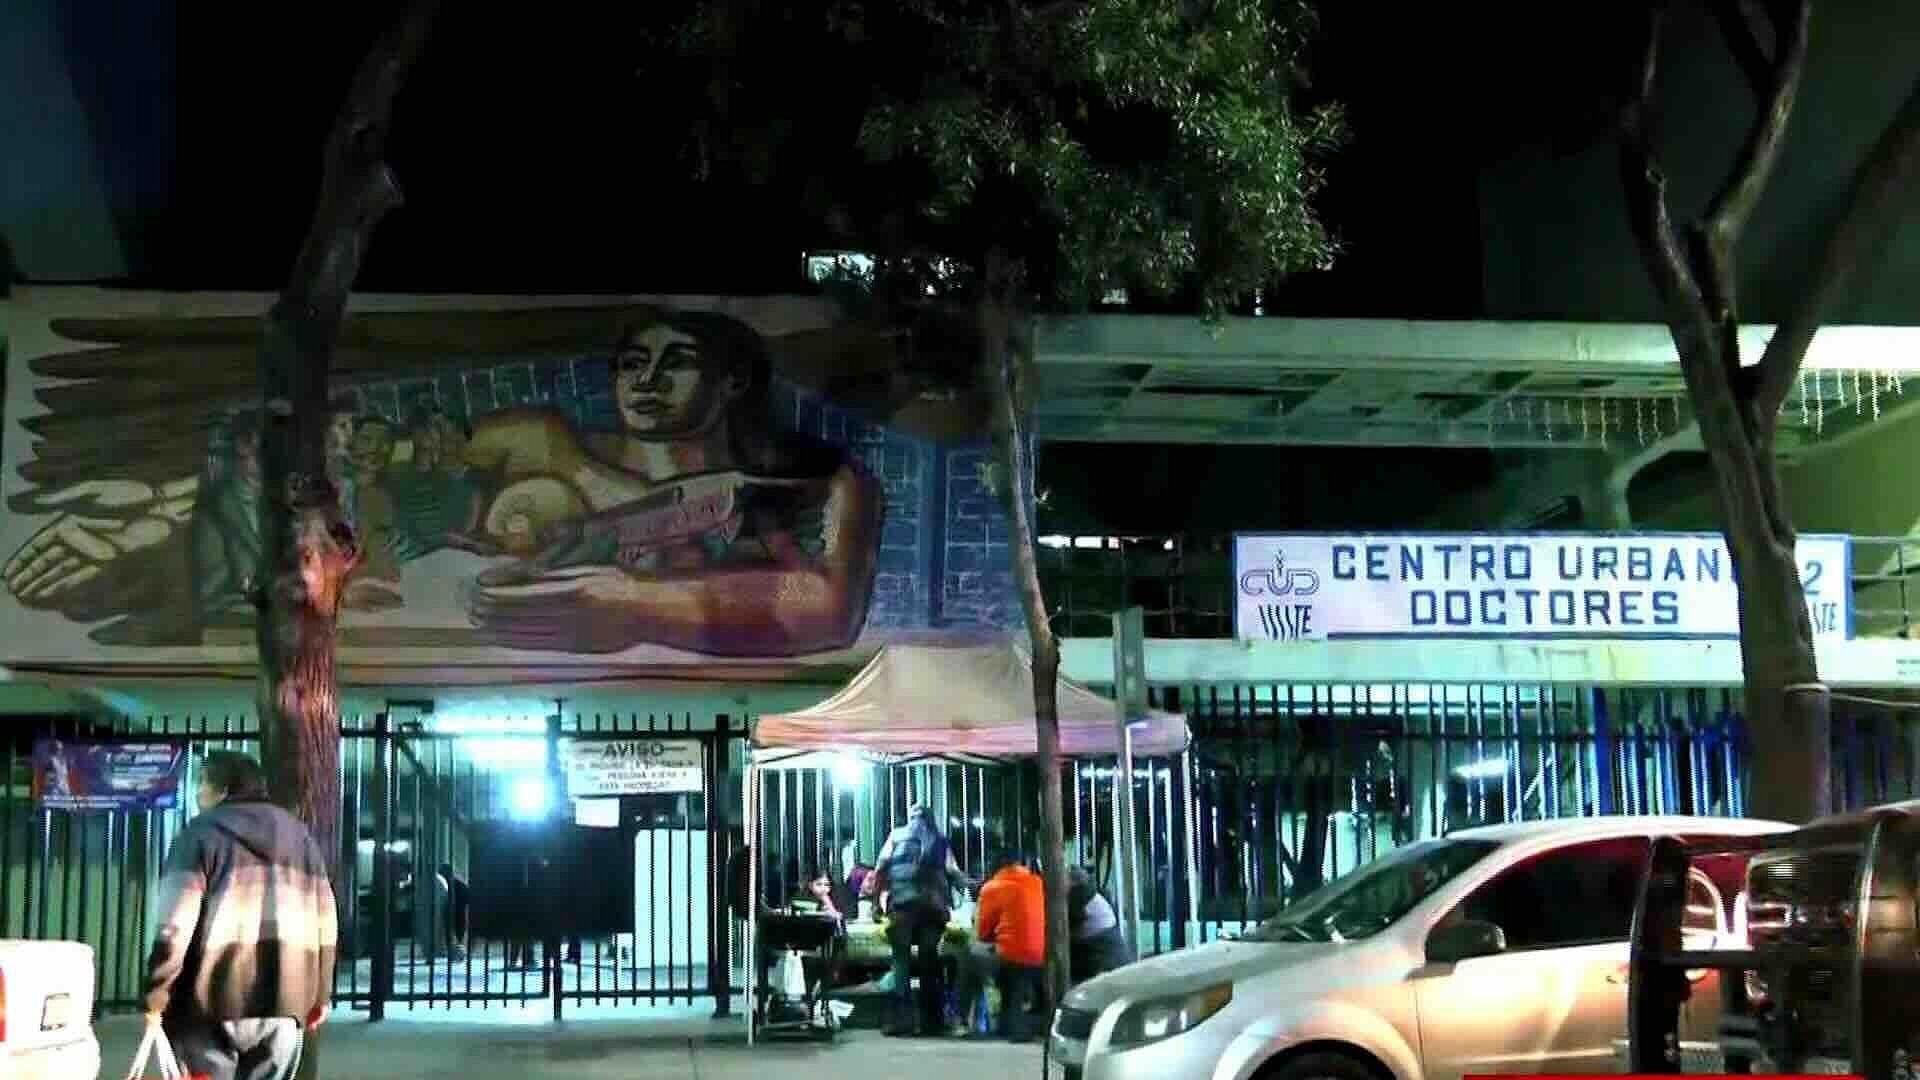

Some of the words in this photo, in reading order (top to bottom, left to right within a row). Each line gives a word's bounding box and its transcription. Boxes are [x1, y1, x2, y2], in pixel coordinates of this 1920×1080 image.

[1332, 545, 1532, 580] CENTRO
[1803, 561, 1823, 594] 2
[1411, 590, 1678, 626] DOCTORES
[602, 743, 665, 758] AVISO
